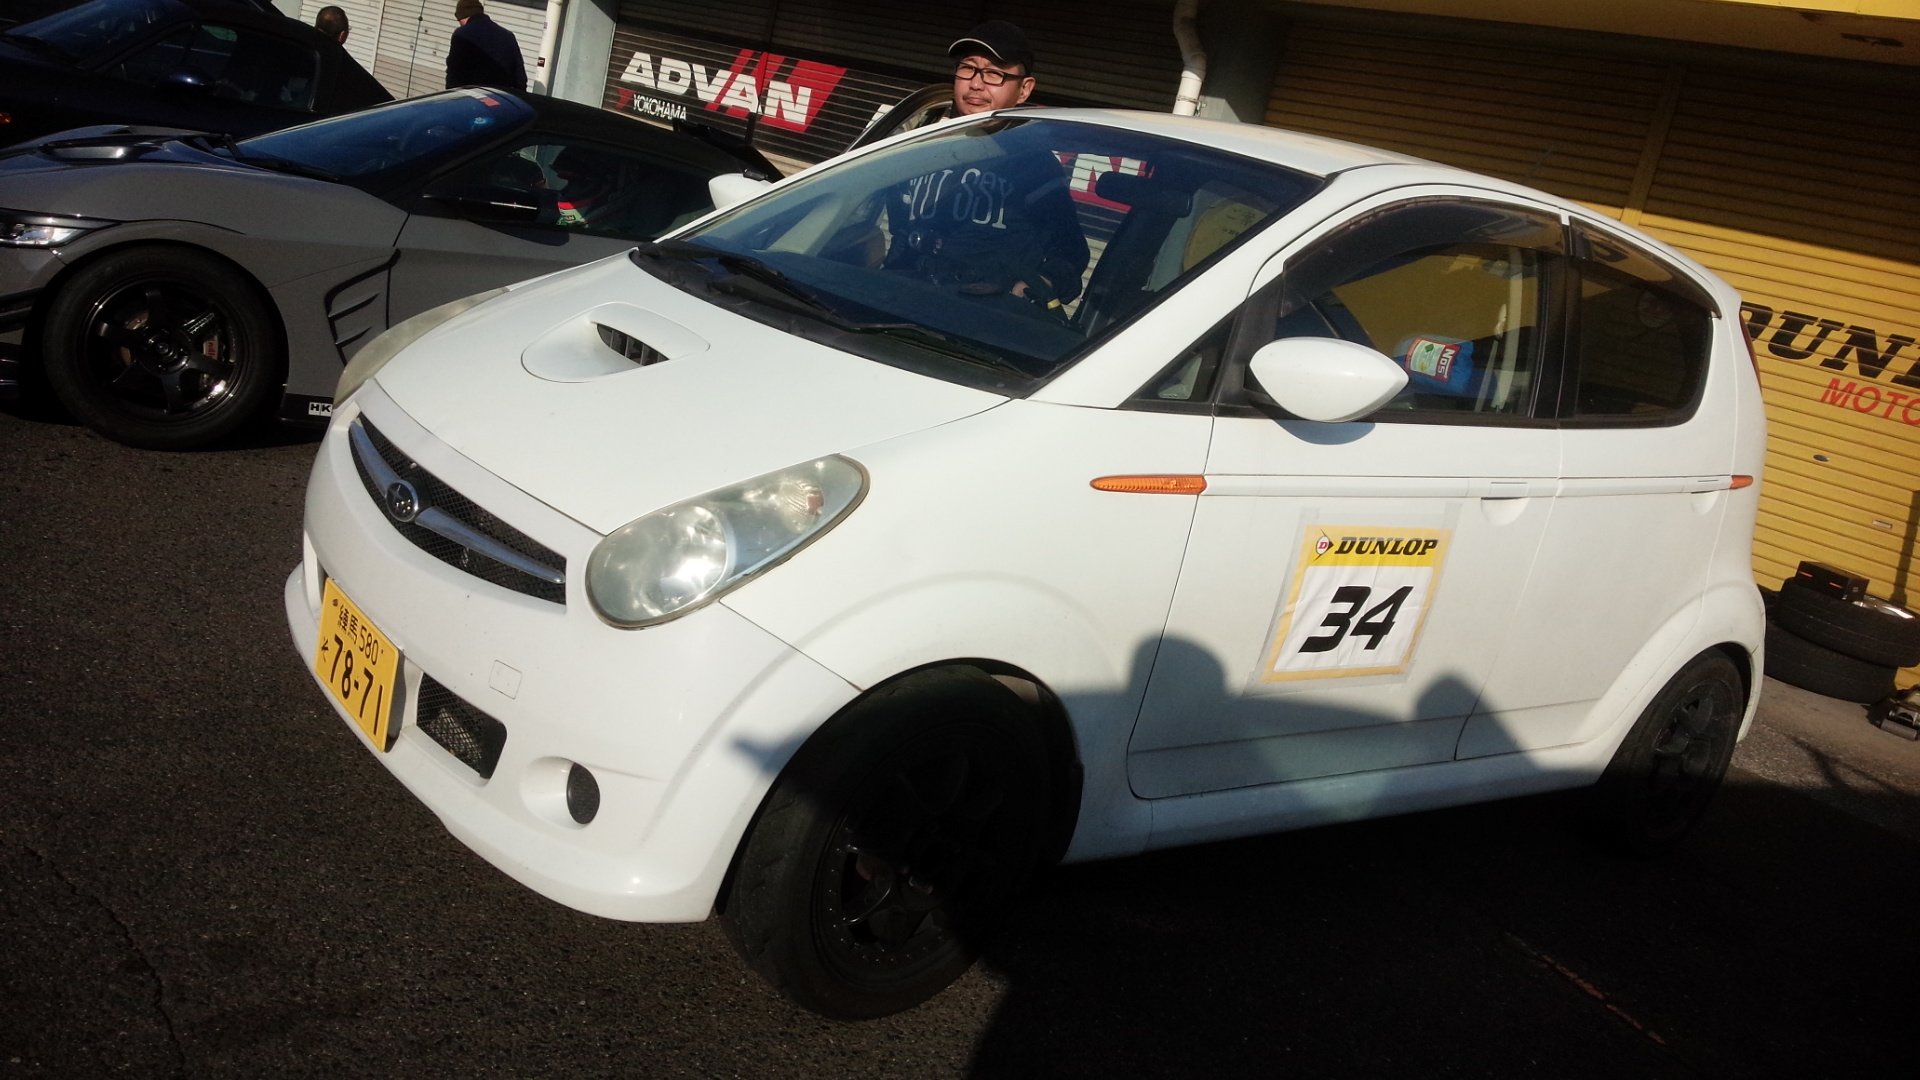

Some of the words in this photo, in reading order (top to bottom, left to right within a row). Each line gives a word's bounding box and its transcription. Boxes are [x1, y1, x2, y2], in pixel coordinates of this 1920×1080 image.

[620, 51, 812, 125] ADVAN
[633, 93, 687, 120] YOKOHAMA
[1437, 348, 1456, 374] NOS
[1819, 377, 1920, 427] MOTO
[1334, 536, 1439, 556] DUNLOP
[1298, 585, 1414, 653] 34
[359, 625, 379, 666] 580
[330, 633, 383, 736] 78-71
